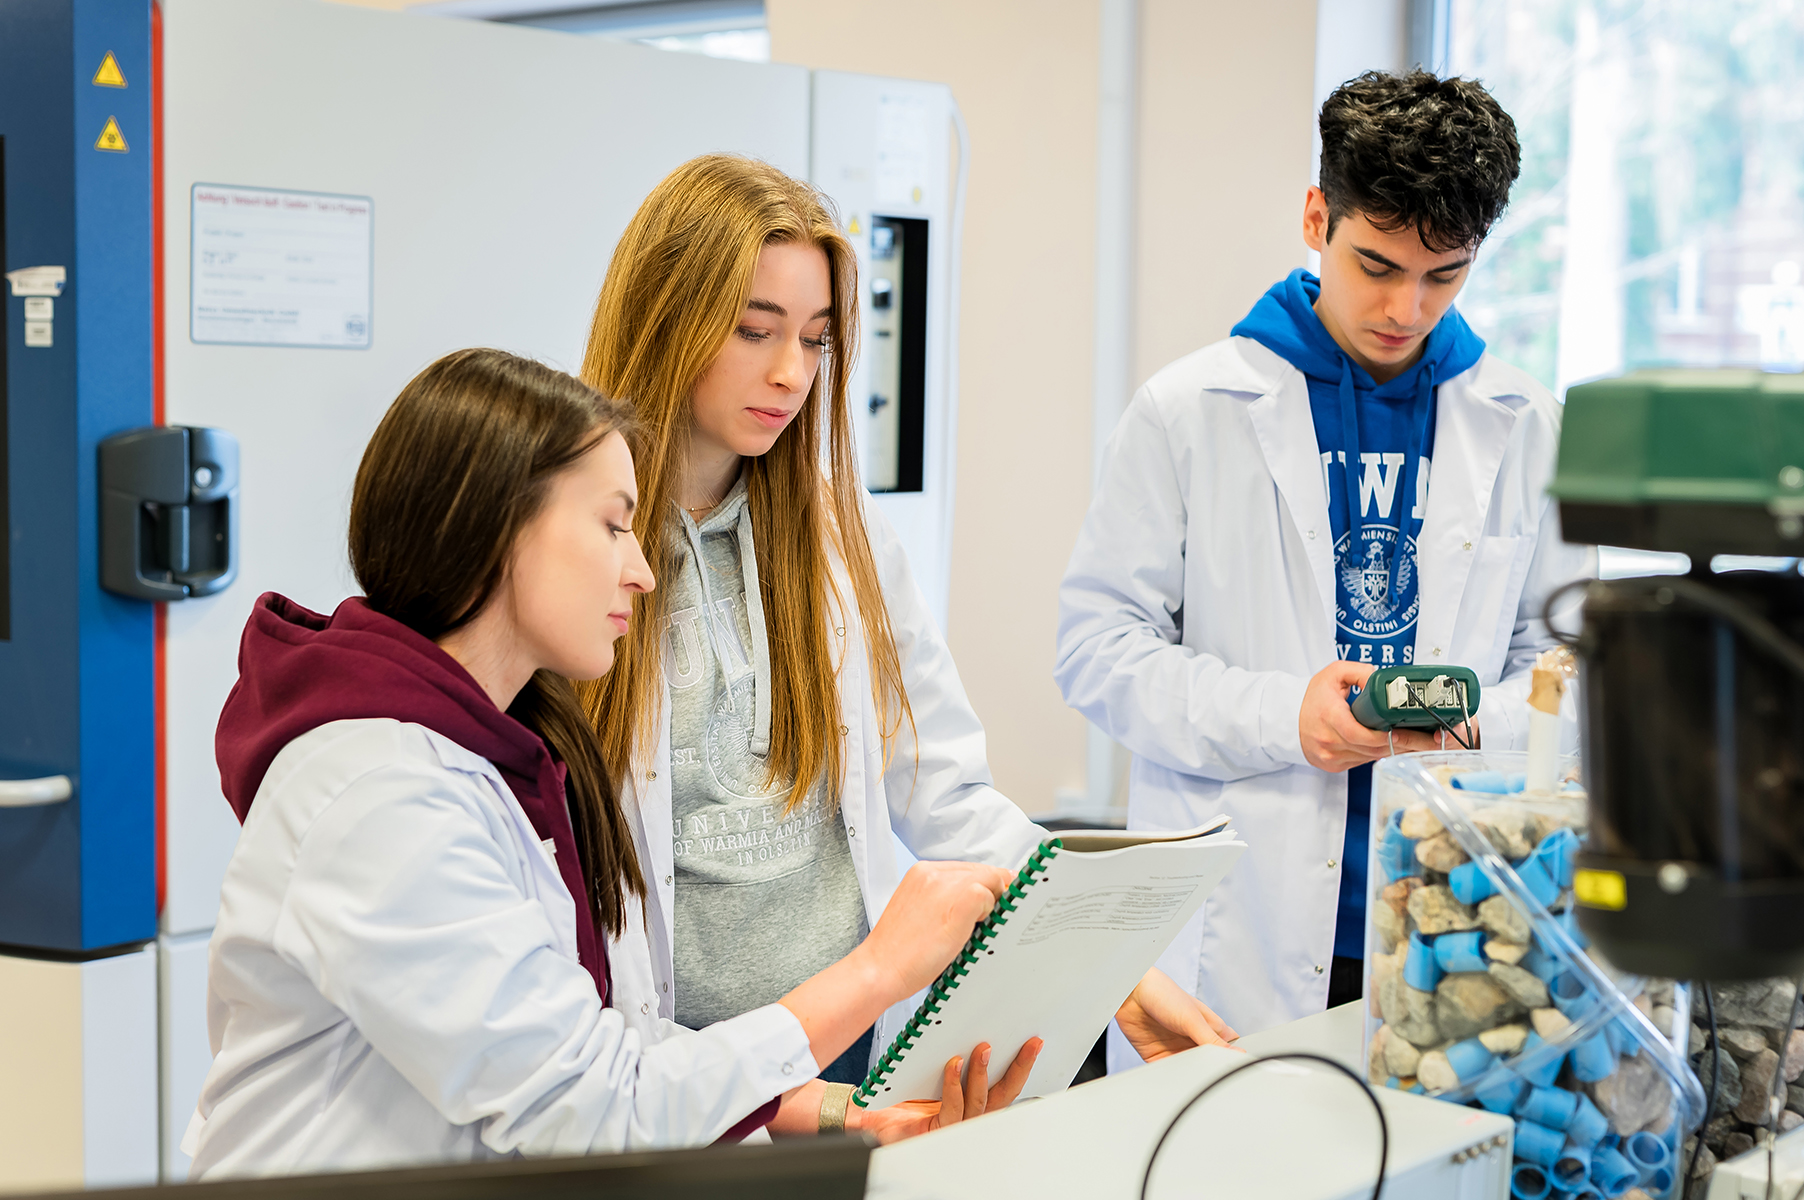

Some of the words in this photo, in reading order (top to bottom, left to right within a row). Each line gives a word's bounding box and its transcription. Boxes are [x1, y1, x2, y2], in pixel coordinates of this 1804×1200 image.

[1353, 619, 1398, 633] OLSTINI
[673, 840, 694, 857] OF
[699, 829, 770, 854] WARMIA
[775, 819, 802, 840] AND
[737, 850, 754, 866] IN
[759, 832, 811, 861] OLSZTYN
